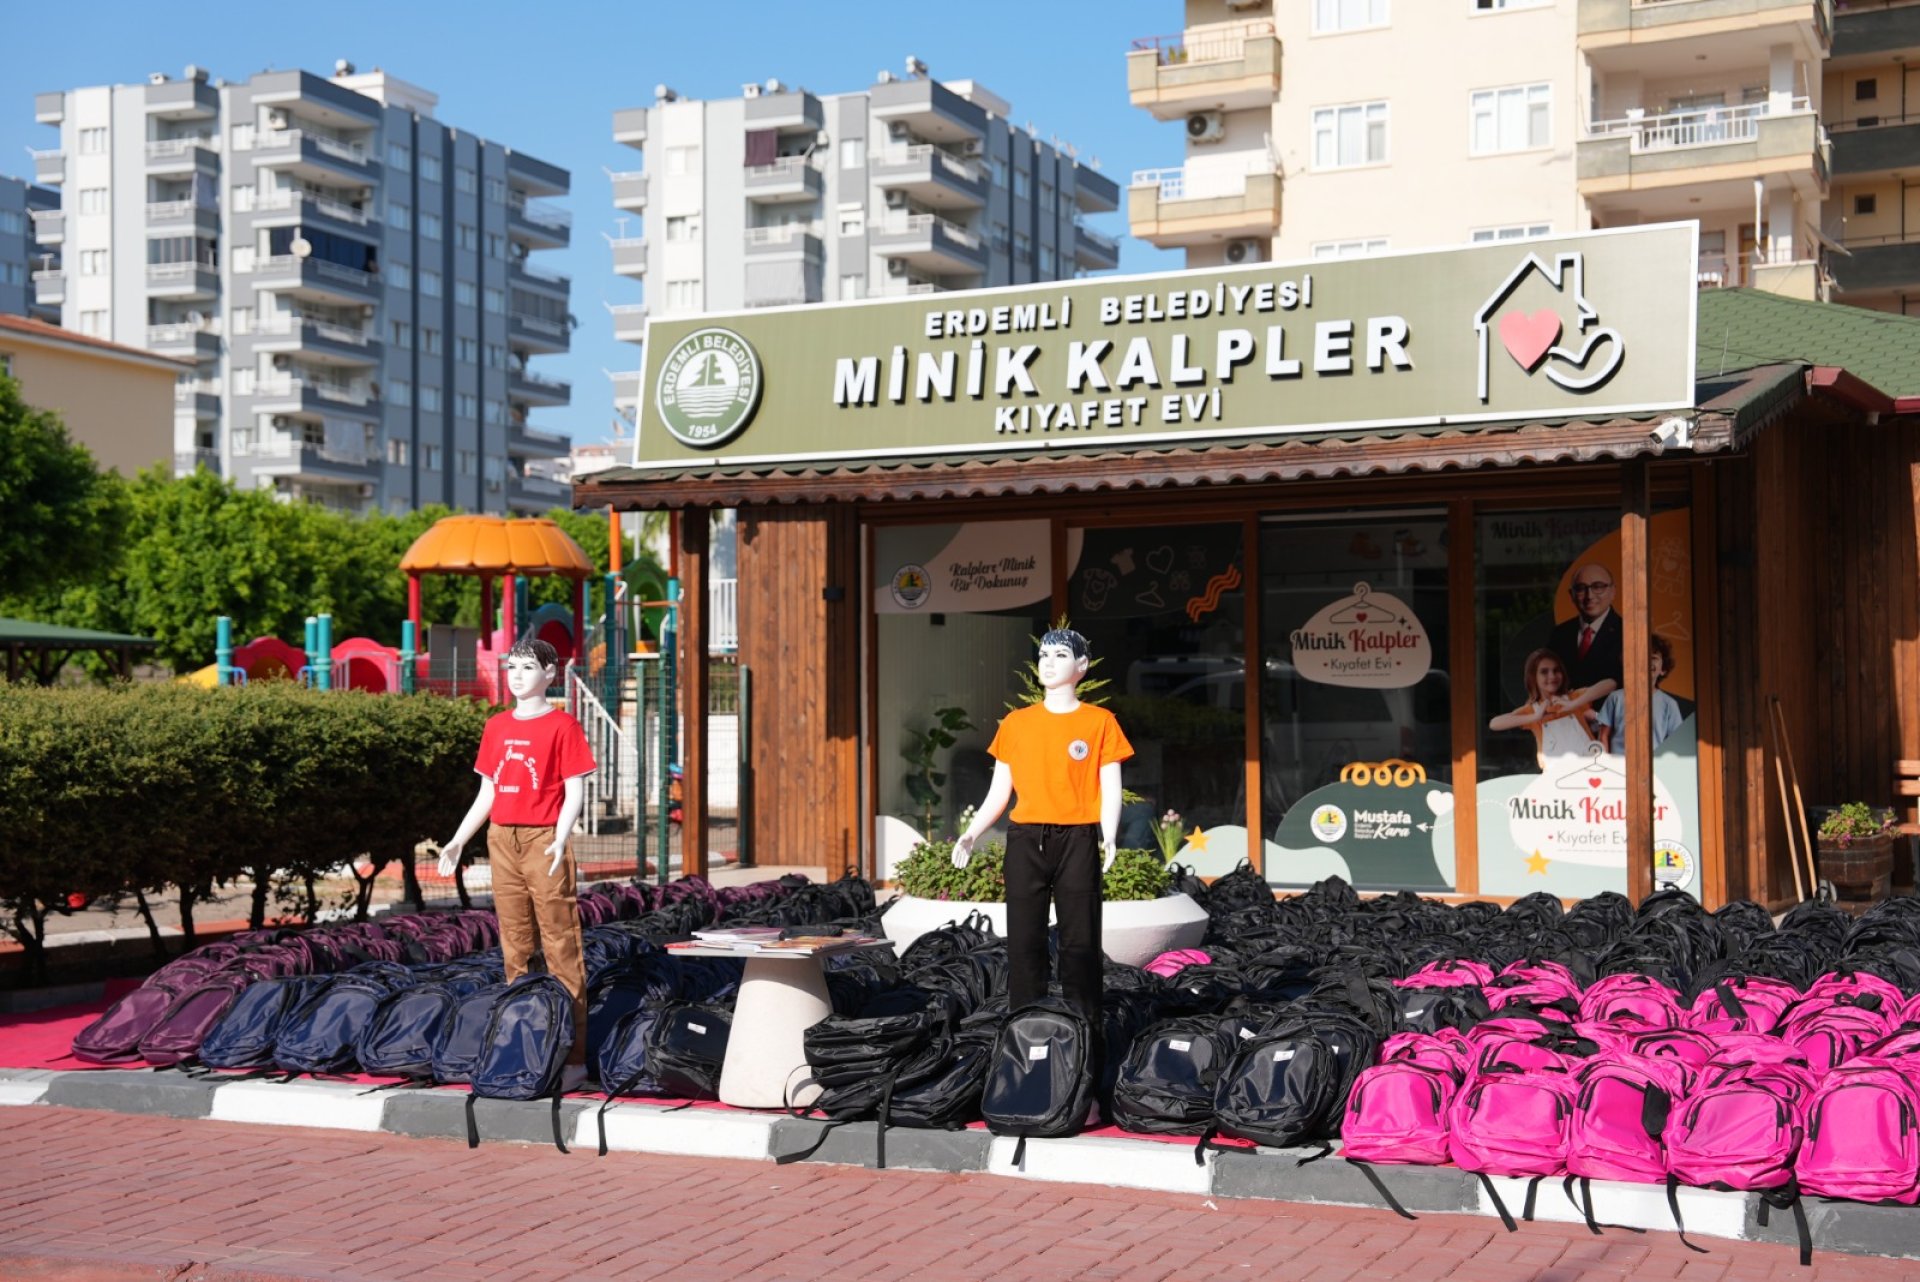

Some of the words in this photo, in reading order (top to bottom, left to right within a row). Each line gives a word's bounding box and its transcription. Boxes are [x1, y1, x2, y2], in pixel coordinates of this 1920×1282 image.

[925, 296, 1071, 337] ERDEMLİ
[1101, 274, 1312, 323] BELEDİYESİ
[833, 340, 1041, 404] MİNİK
[1066, 315, 1412, 390] KALPLER
[663, 337, 700, 406] ERDEMLİ
[703, 335, 751, 404] BELEDİYESİ
[995, 398, 1147, 433] KIYAFET
[1161, 387, 1222, 422] EVİ
[688, 424, 717, 438] 1954
[998, 555, 1036, 572] Minik
[1292, 631, 1346, 650] Minik
[1348, 629, 1421, 654] Kalpler
[1330, 657, 1370, 672] Kıyafet
[1375, 657, 1392, 670] Evi
[1353, 809, 1412, 824] Mustafa
[1509, 797, 1576, 820] Minik
[1373, 823, 1410, 839] Kara
[1557, 829, 1606, 848] Kıyafet
